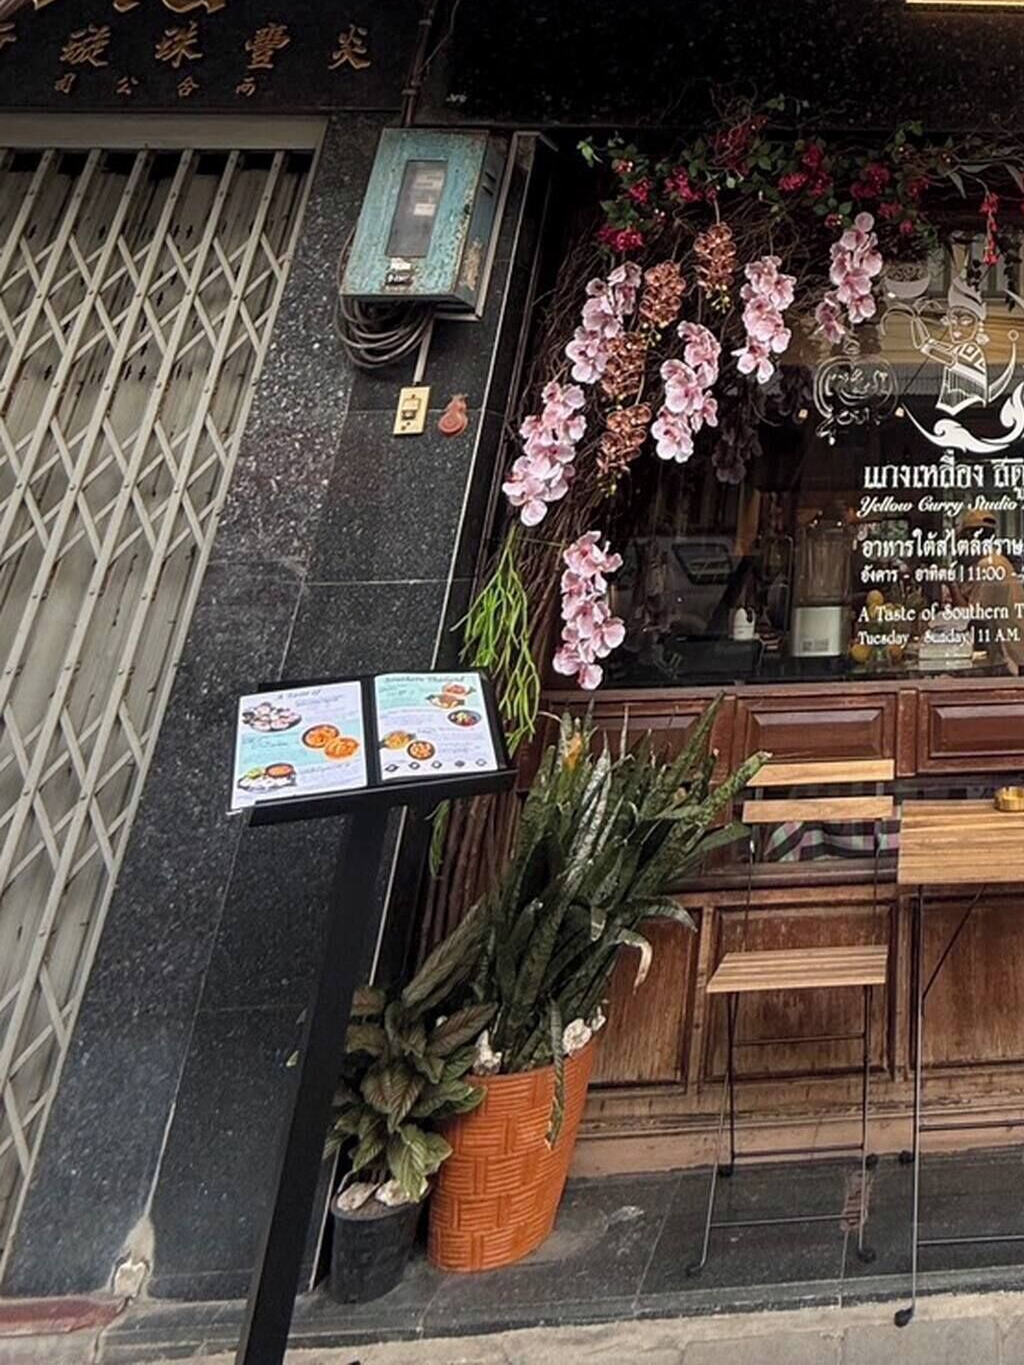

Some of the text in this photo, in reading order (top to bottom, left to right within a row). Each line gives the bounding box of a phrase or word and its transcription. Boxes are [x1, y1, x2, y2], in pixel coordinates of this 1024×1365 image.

[863, 449, 985, 489] แกงเหลือง
[856, 496, 912, 517] Yellow
[918, 496, 964, 516] Curry
[967, 495, 1017, 512] Studio
[861, 564, 897, 582] อังคาร
[915, 562, 955, 582] อาทิตย์
[968, 566, 1006, 581] 11:00
[858, 606, 869, 622] A
[876, 605, 916, 622] Taste
[921, 602, 938, 621] of
[942, 602, 1009, 621] Southern
[858, 630, 910, 648] Tuesday
[923, 629, 969, 646] Sunday
[978, 629, 991, 643] 11
